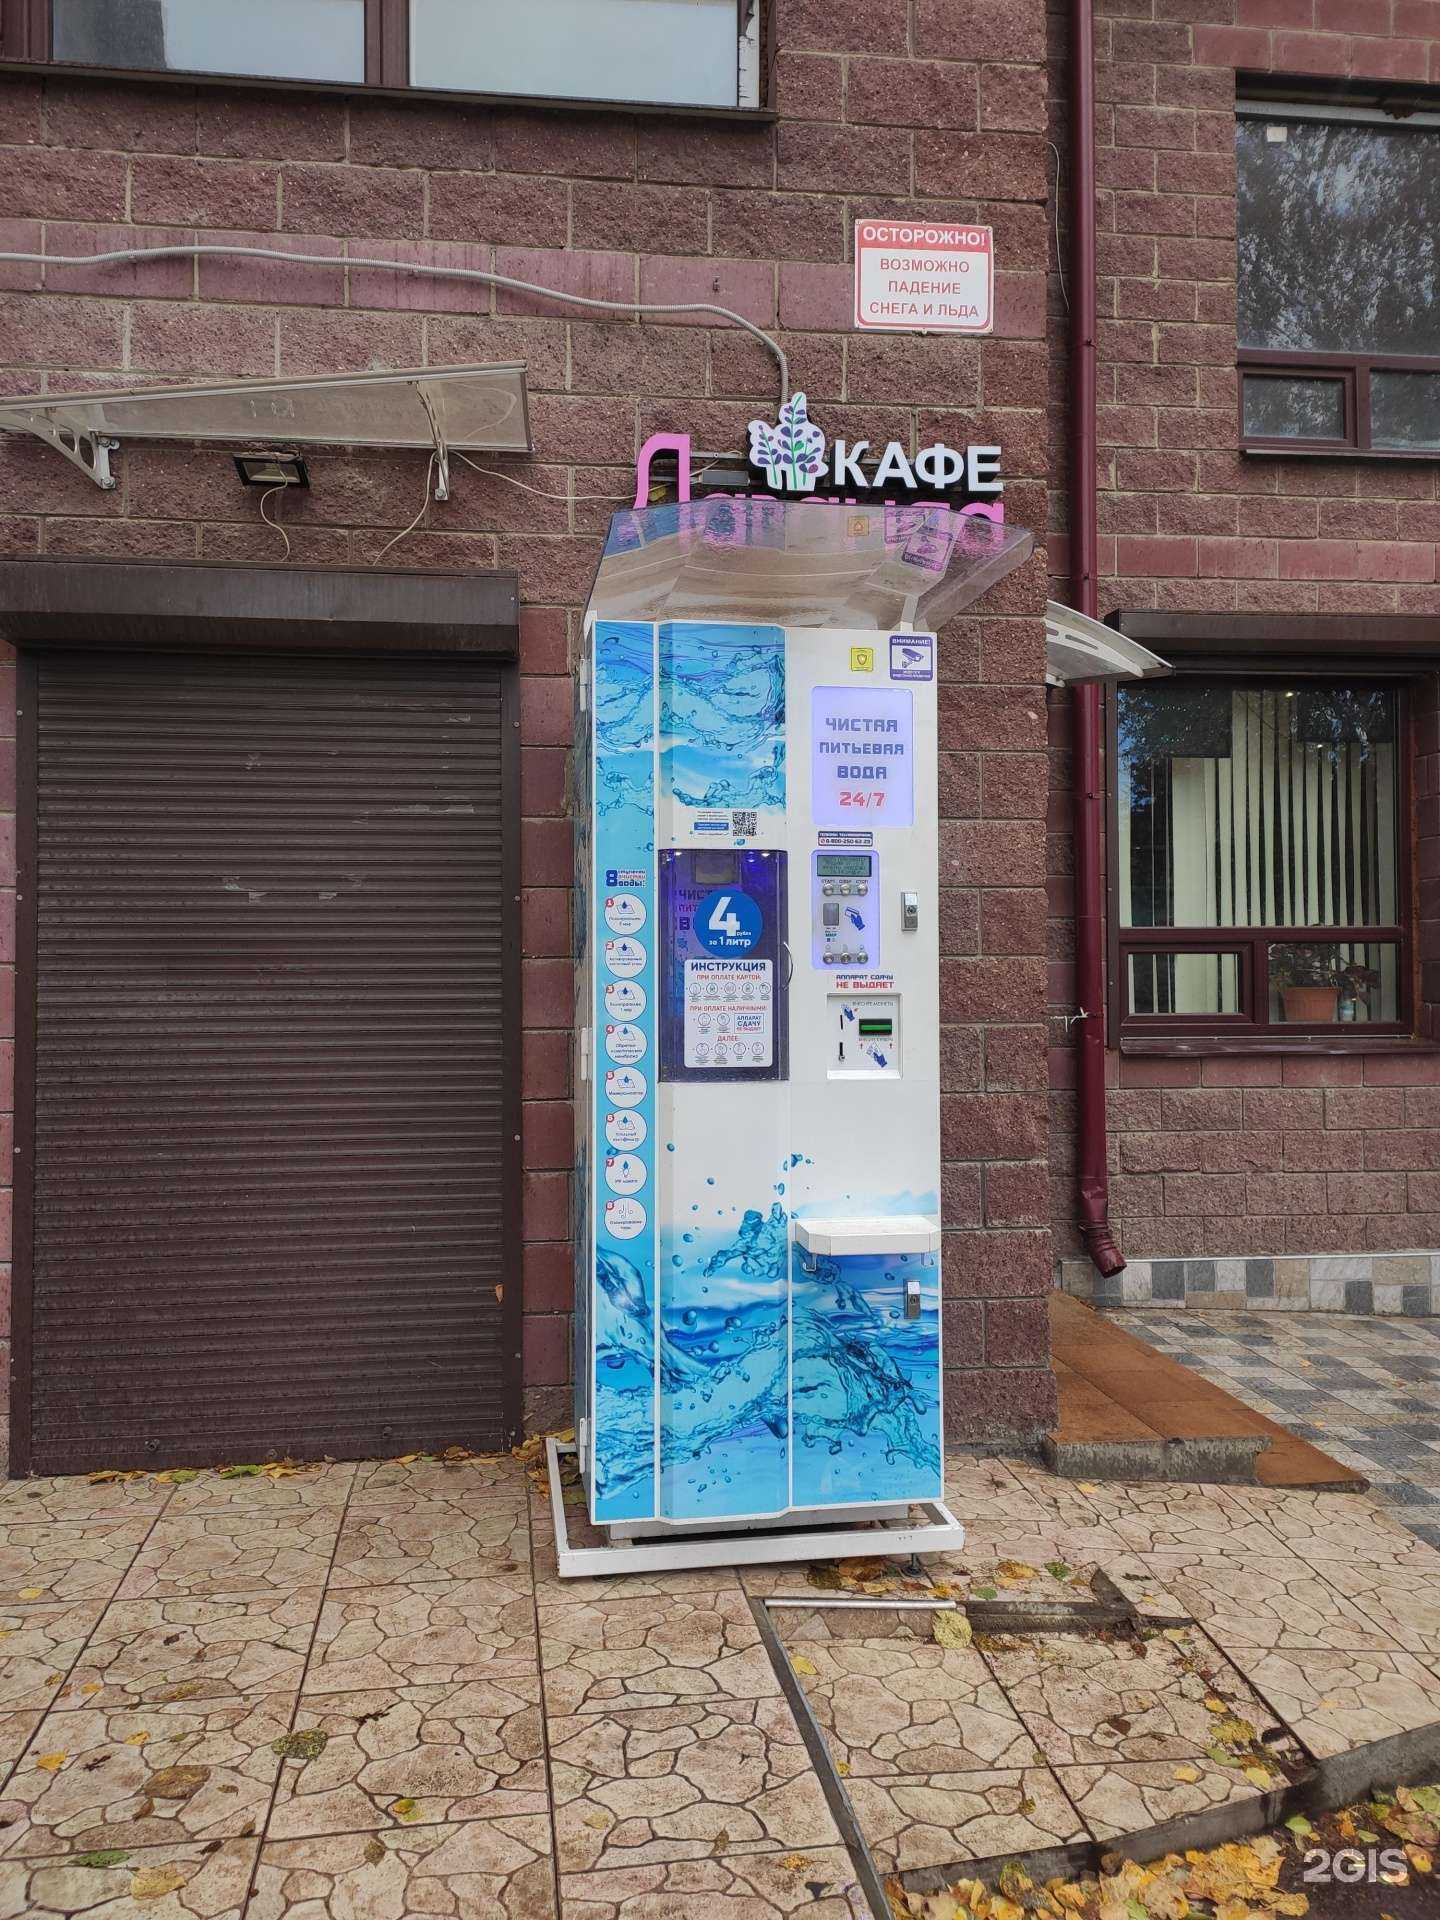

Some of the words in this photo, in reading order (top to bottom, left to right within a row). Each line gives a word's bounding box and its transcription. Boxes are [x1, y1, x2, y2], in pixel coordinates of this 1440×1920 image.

[863, 226, 986, 246] ОСТОРОЖНО!
[880, 258, 970, 273] ВОЗМОЖНО
[888, 280, 961, 295] ПАДЕНИЕ
[870, 302, 917, 315] СНЕГА
[923, 303, 933, 315] И
[938, 304, 979, 318] ЛЬДА
[834, 439, 1004, 492] КАФЕ
[826, 718, 898, 732] ЧИСТАЯ
[819, 742, 904, 755] ПИТЬЕВАЯ
[837, 766, 887, 780] ВОДА
[839, 792, 885, 808] 24/7
[606, 870, 618, 886] 8
[708, 896, 740, 936] 4
[719, 936, 724, 946] 1
[725, 938, 751, 947] литр
[691, 962, 766, 972] ИНСТРУКЦИЯ
